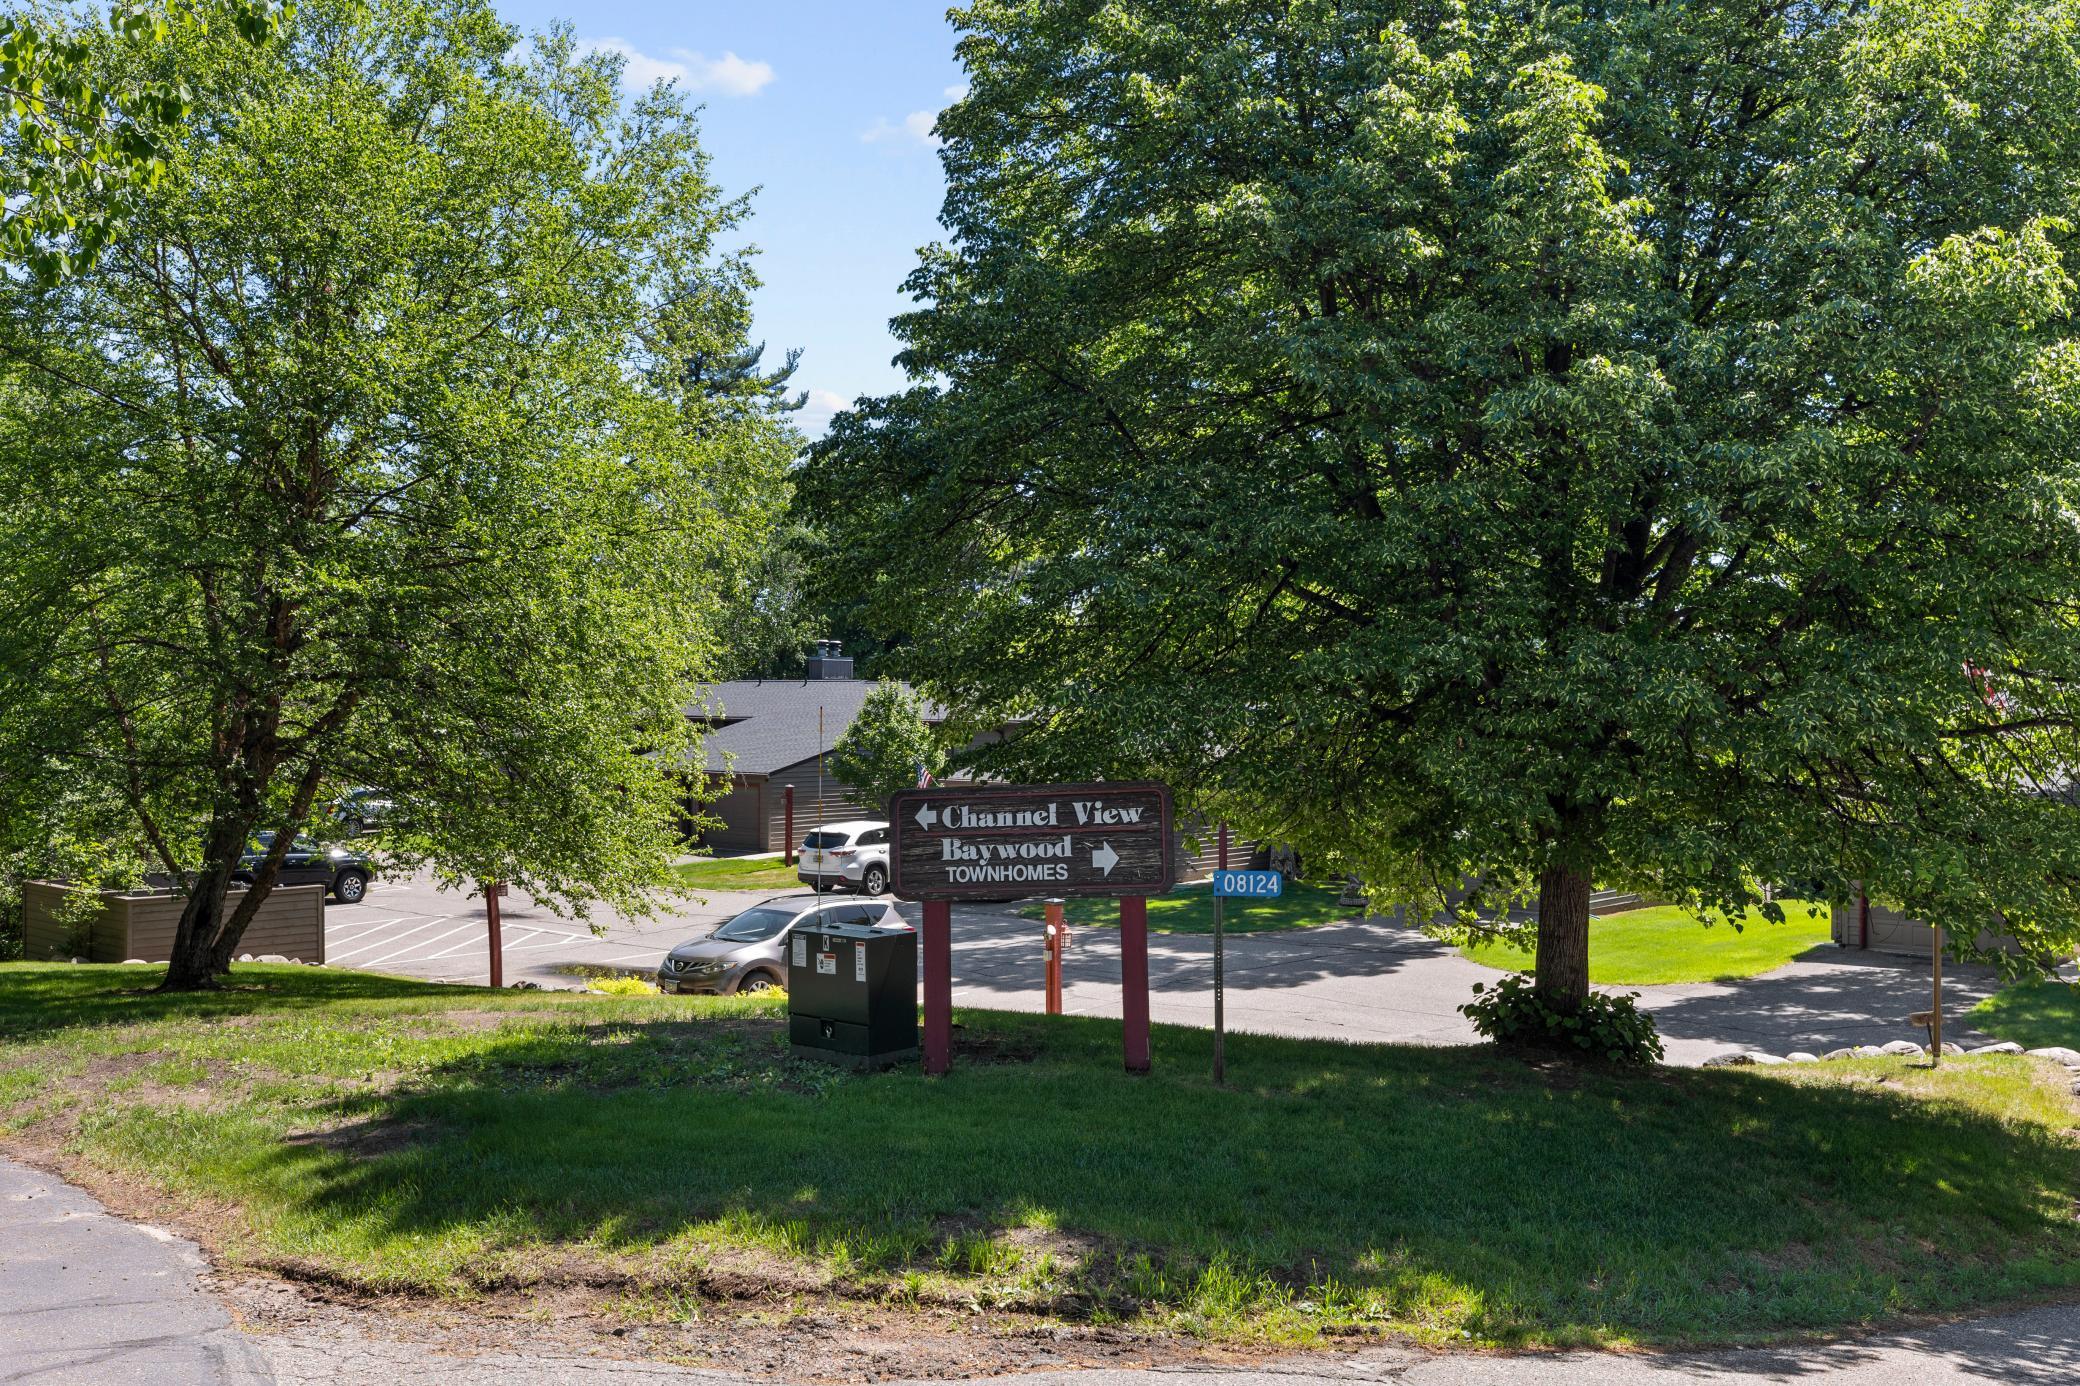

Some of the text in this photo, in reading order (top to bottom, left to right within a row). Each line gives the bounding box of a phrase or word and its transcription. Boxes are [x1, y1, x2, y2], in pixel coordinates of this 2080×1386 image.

[942, 800, 1144, 828] Channel View
[941, 835, 1073, 865] Baywood
[946, 864, 1069, 883] TOWNHOMES
[1224, 874, 1278, 893] 08124
